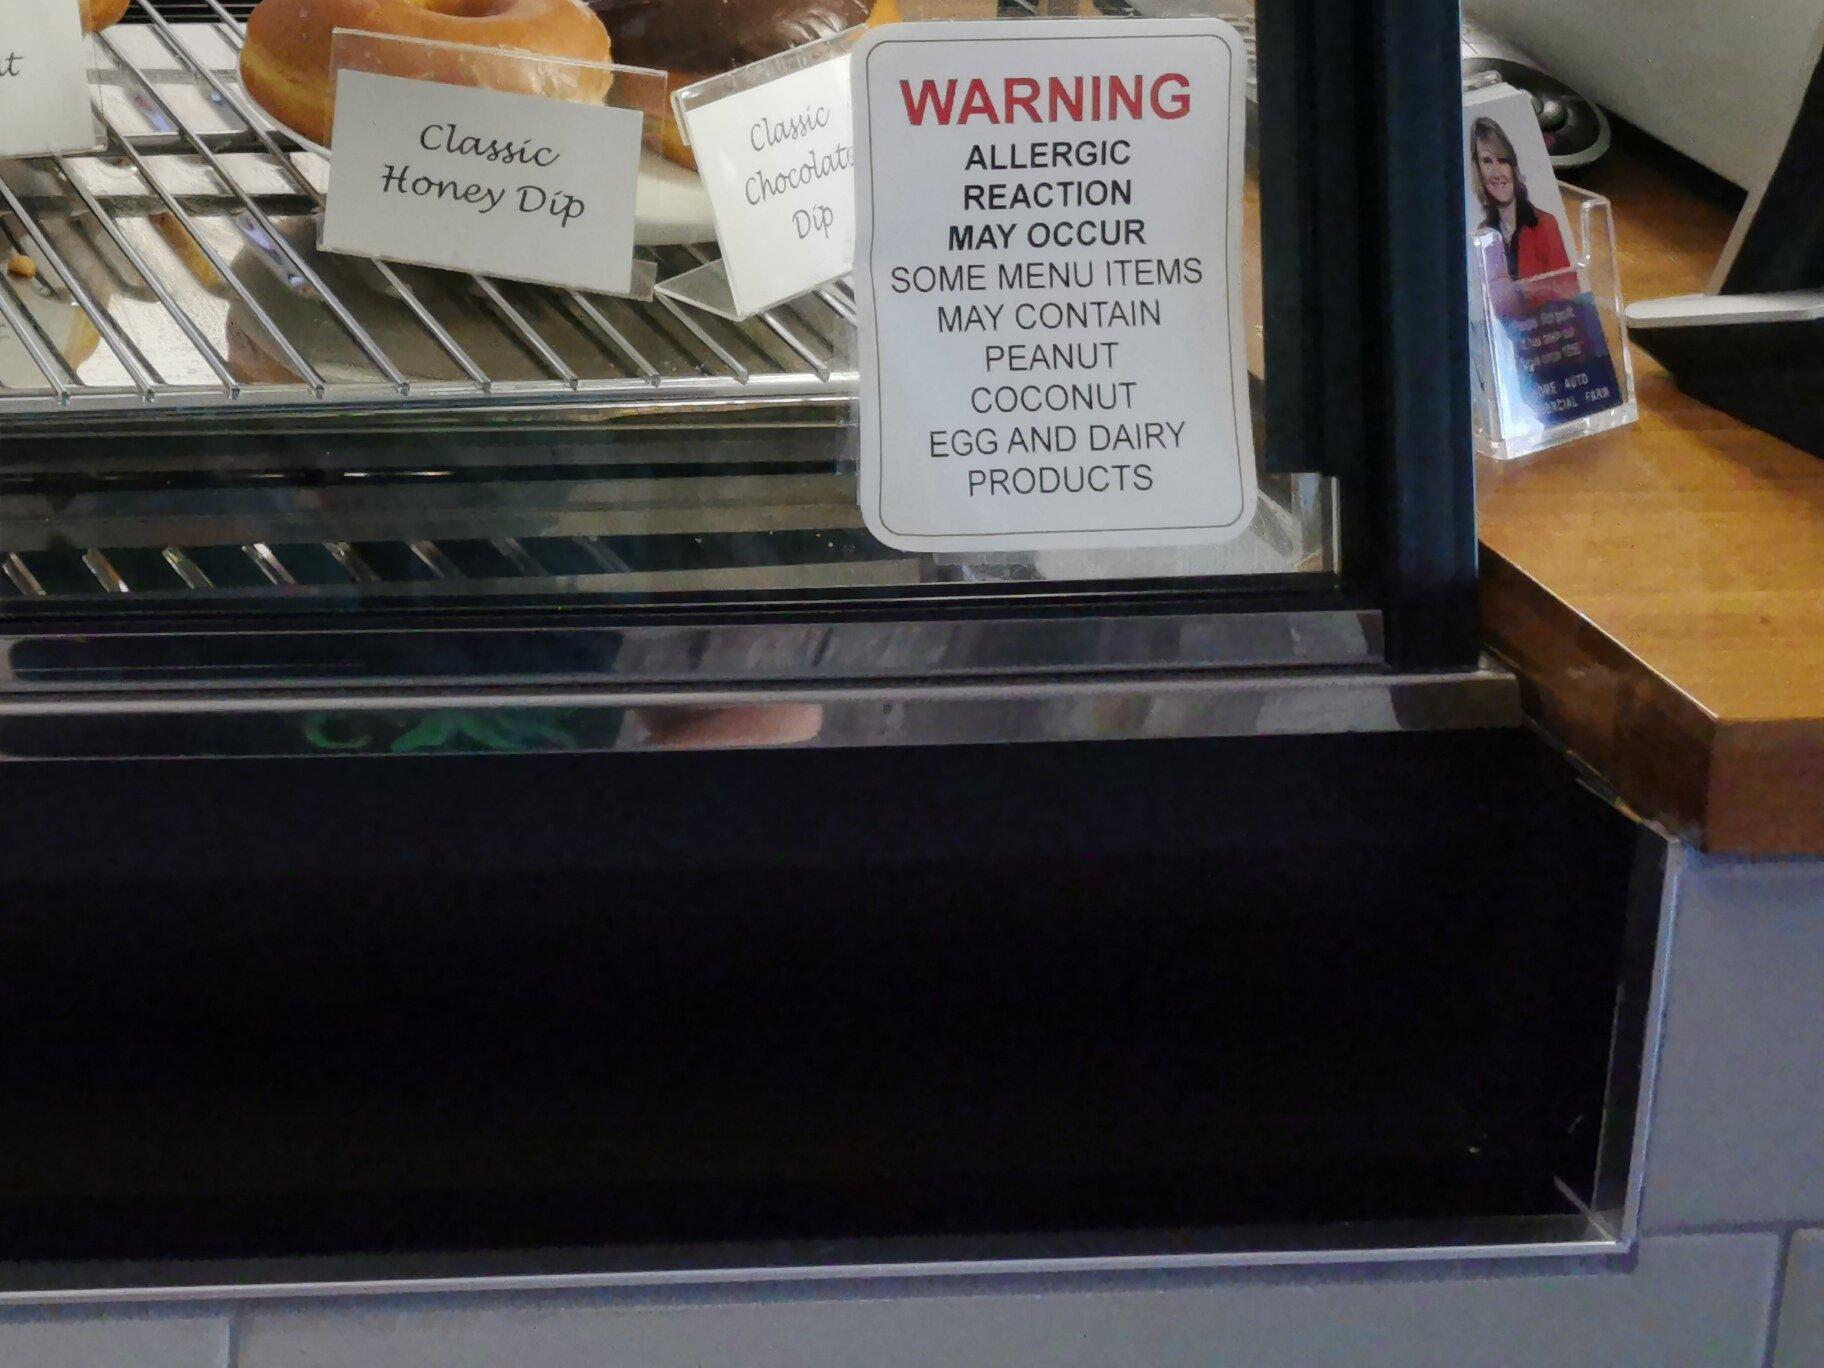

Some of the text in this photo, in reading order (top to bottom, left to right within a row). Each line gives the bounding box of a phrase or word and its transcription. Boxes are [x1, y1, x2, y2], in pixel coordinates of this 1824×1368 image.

[899, 73, 1192, 126] WARNING
[419, 123, 559, 168] Classic
[749, 104, 831, 153] Classic
[964, 139, 1132, 171] ALLERGIC
[381, 164, 586, 228] Honey Dip
[963, 179, 1132, 210] REACTION
[792, 203, 835, 241] Dip
[948, 218, 1148, 251] MAY OCCUR
[891, 257, 1203, 293] SOME MENU ITEMS
[937, 300, 1161, 333] MAY CONTAIN
[985, 342, 1119, 372] PEANUT
[970, 382, 1137, 413] COCONUT
[929, 421, 1186, 458] EGG AND DAIRY
[968, 464, 1153, 496] PRODUCTS
